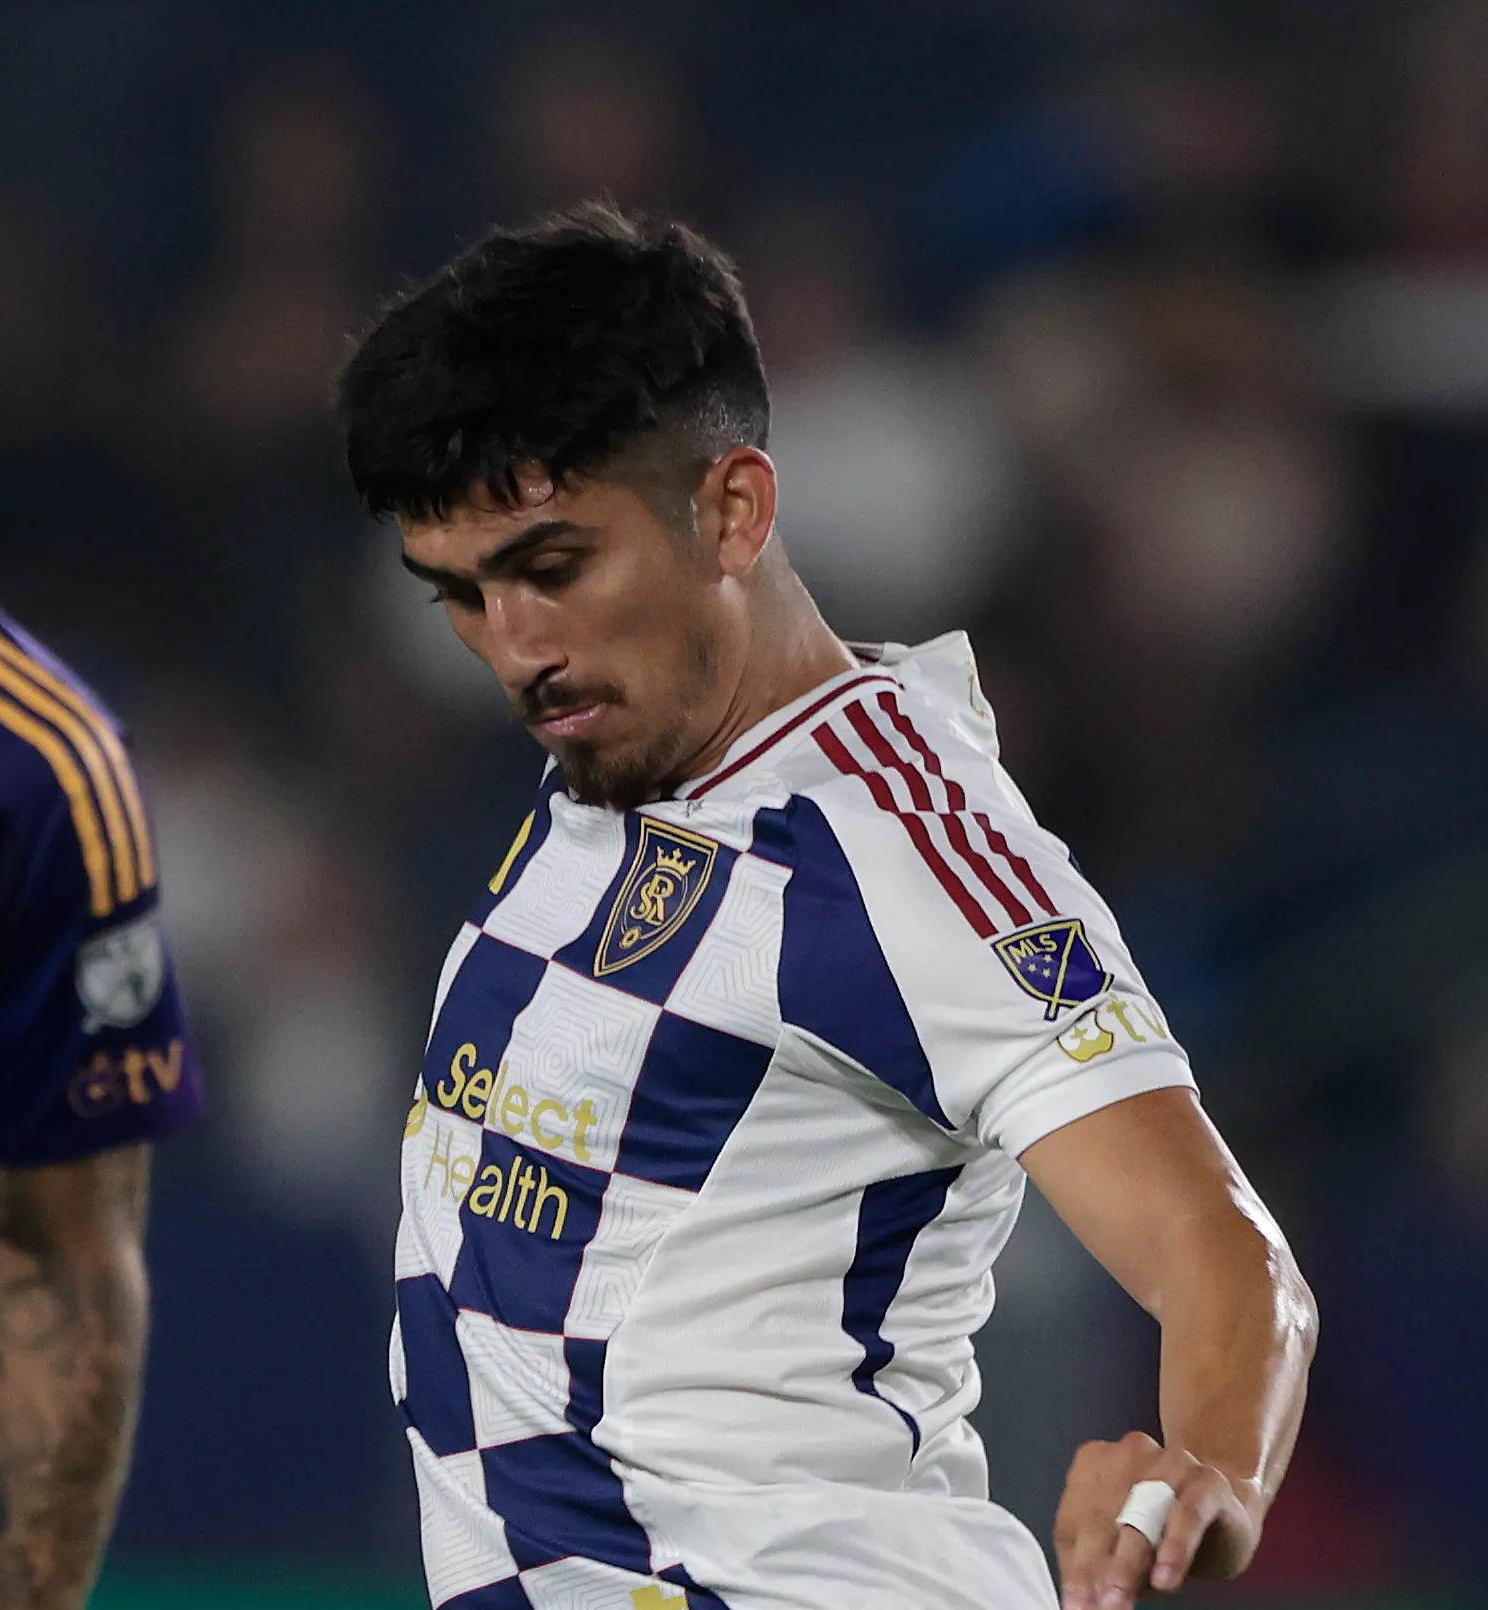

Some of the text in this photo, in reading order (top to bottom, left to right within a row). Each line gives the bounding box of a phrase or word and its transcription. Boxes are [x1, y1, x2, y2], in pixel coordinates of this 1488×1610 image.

[1007, 933, 1059, 965] MLS
[436, 1042, 598, 1162] Select
[423, 1124, 569, 1241] Health
